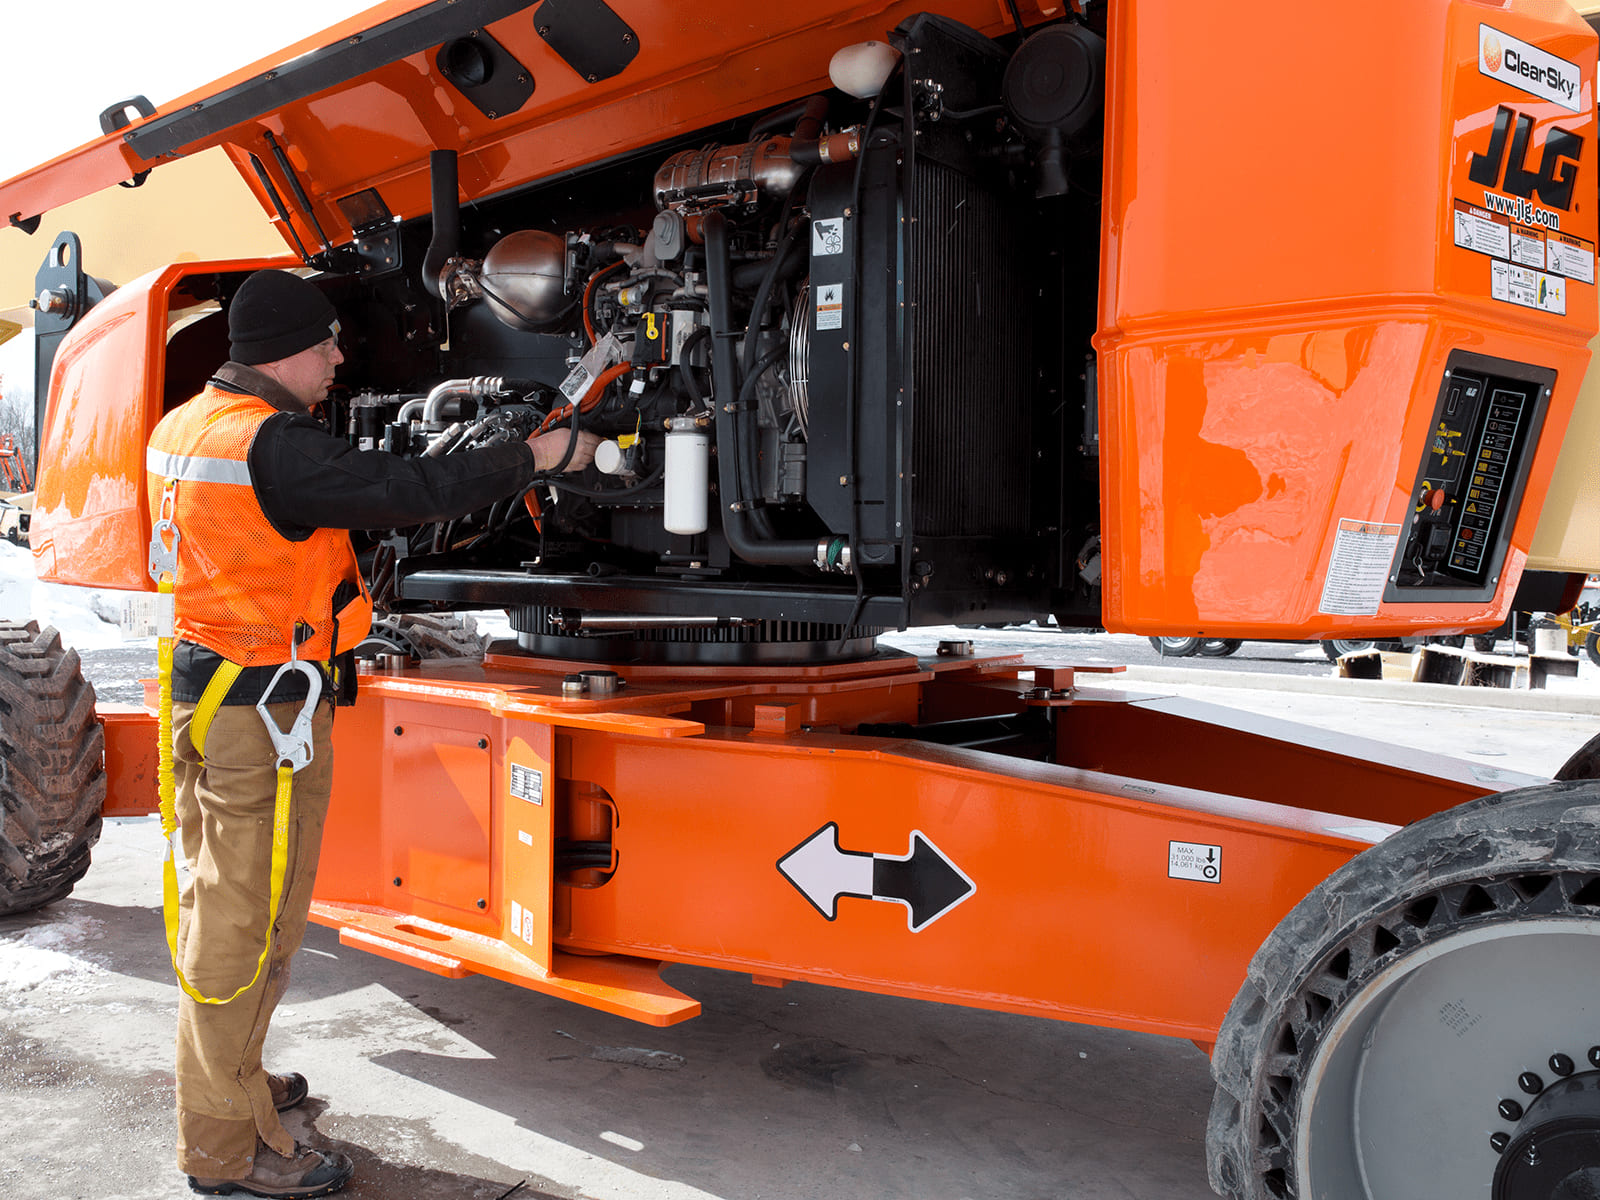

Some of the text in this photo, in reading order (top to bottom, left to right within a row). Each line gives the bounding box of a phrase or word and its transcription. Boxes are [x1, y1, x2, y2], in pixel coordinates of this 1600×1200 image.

[1504, 48, 1575, 101] ClearSky
[1468, 104, 1585, 212] JLG
[1472, 208, 1492, 220] DANGER
[1484, 191, 1560, 229] www.jlg.com
[1520, 227, 1539, 239] WARNING
[1563, 236, 1581, 247] WARNING
[1177, 847, 1194, 855] MAX
[1171, 860, 1203, 871] 14,061 kg
[1196, 856, 1206, 864] lbs
